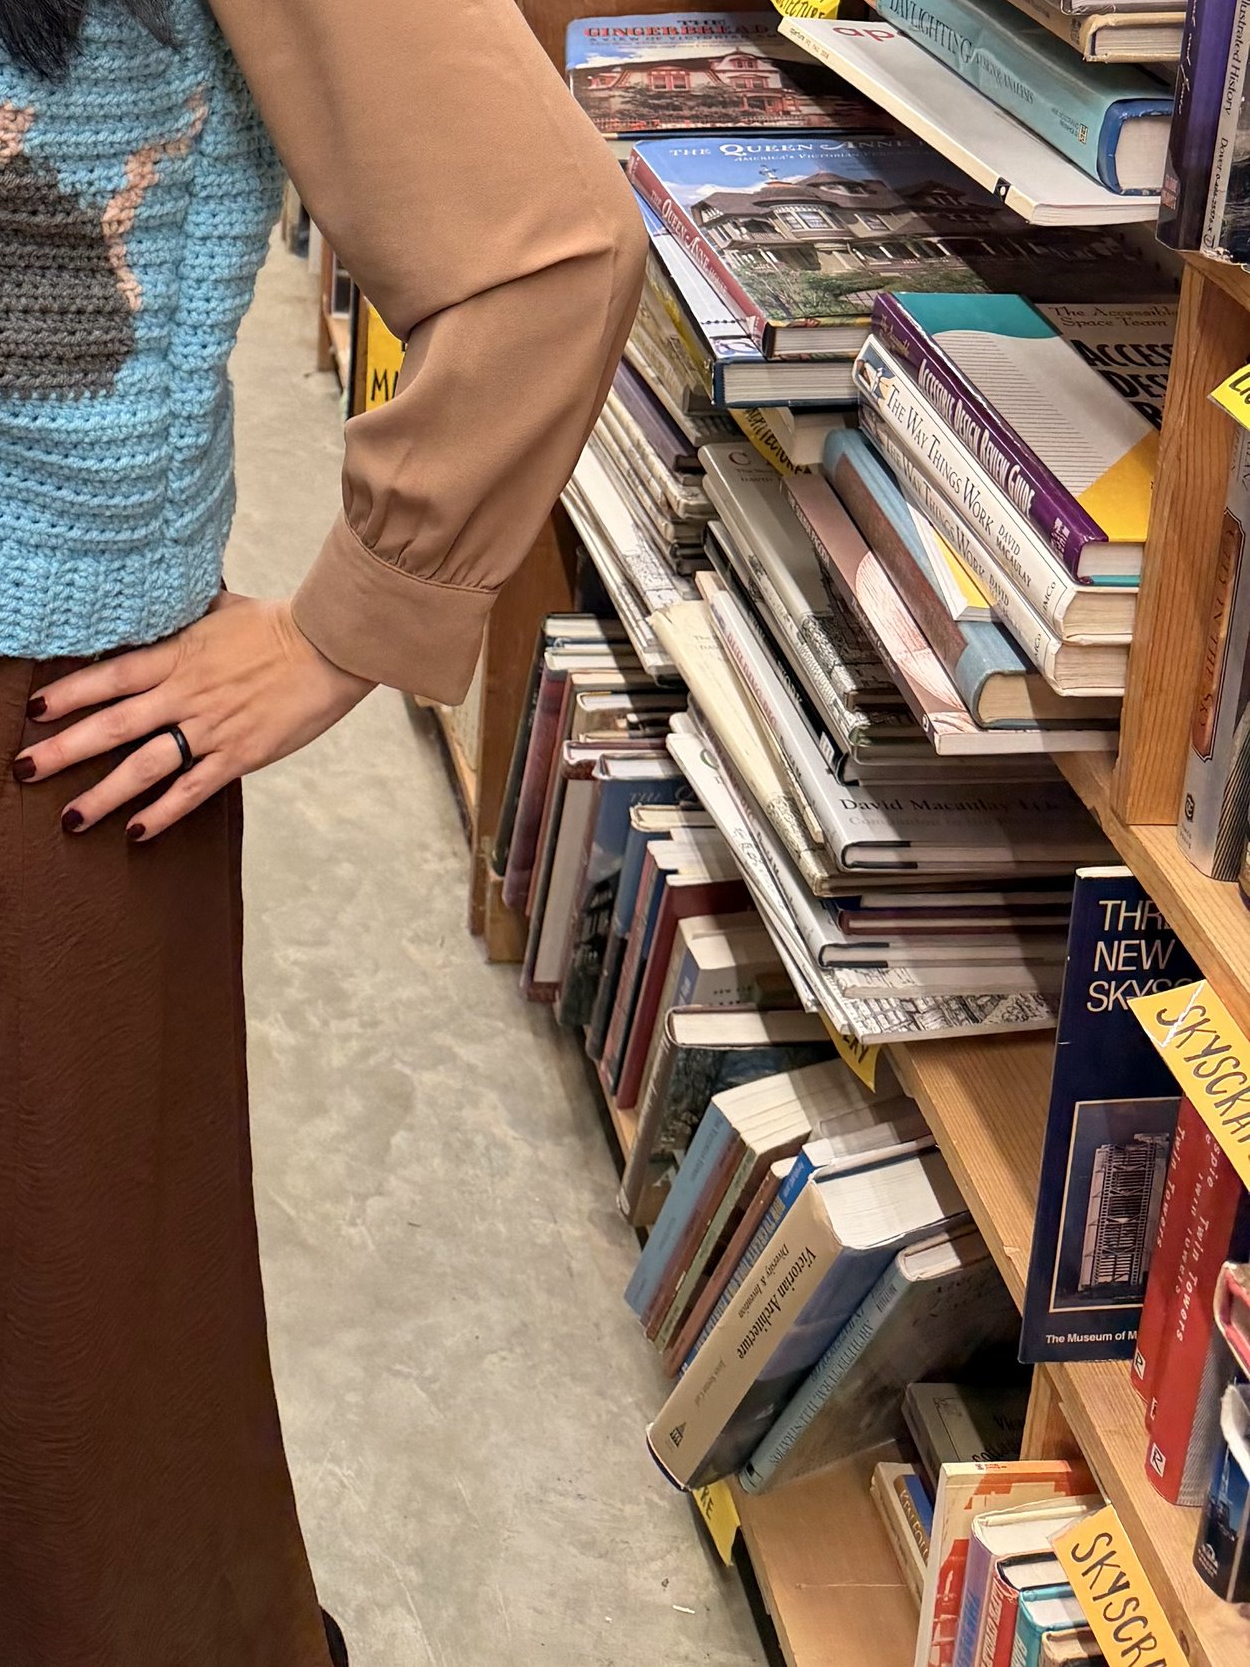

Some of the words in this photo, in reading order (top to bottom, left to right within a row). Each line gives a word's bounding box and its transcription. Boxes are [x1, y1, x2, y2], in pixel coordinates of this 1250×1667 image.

[584, 24, 769, 37] GINGERBREAD
[1225, 61, 1241, 116] History
[669, 148, 712, 157] THE
[719, 142, 813, 158] QUEEN
[1049, 306, 1087, 318] The
[1093, 304, 1180, 317] Accessible
[1060, 316, 1111, 329] Space
[1117, 316, 1168, 328] Team
[917, 358, 954, 420] ACCESSIBLE
[953, 397, 983, 456] DESIGN
[980, 428, 1011, 492] REVIEW
[1006, 463, 1036, 517] GUIDE
[886, 379, 908, 424] THE
[905, 405, 929, 451] WAY
[927, 433, 962, 495] THINGS
[960, 476, 996, 535] WORK
[997, 523, 1021, 557] DAVID
[952, 524, 987, 583] WORK
[988, 572, 1011, 608] DAVID
[996, 534, 1033, 590] MACAULAY
[838, 798, 907, 812] David
[910, 797, 1008, 813] Macaulay
[1093, 938, 1176, 972] NEW
[1155, 1004, 1250, 1164] SKYSCRA
[1170, 1125, 1186, 1171] Twin
[1156, 1182, 1176, 1249] Towers
[1194, 1215, 1210, 1262] Twin
[761, 1242, 790, 1282] Diversity
[779, 1246, 817, 1305] Victorian
[736, 1291, 784, 1361] Architecture
[737, 1285, 765, 1320] Invention
[1177, 1274, 1200, 1343] Towers
[1045, 1333, 1066, 1344] The
[1066, 1332, 1113, 1344] Museum
[1115, 1331, 1127, 1342] of
[1070, 1530, 1172, 1667] SKYSCR
